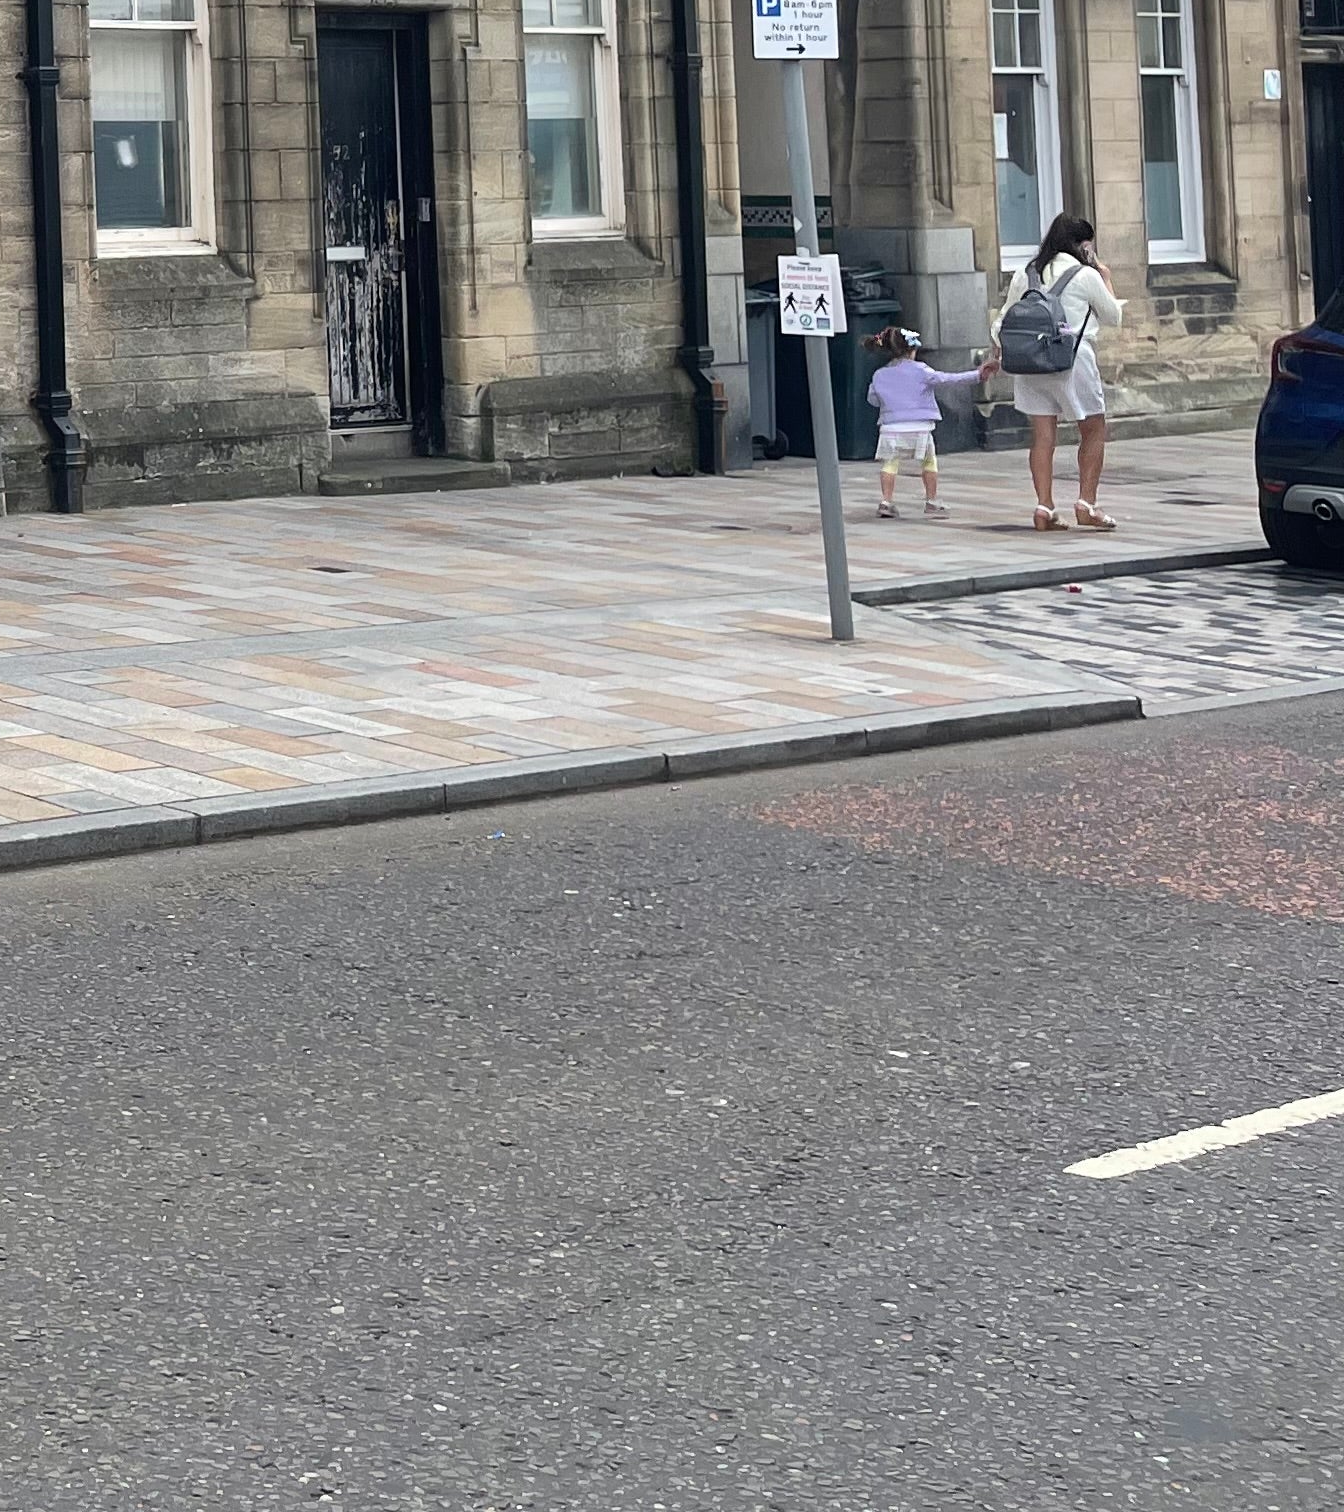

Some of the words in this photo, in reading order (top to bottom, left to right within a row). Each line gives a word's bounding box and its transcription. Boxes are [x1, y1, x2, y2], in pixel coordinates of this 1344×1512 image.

[802, 10, 823, 19] hour
[772, 23, 785, 31] No
[764, 33, 793, 41] within
